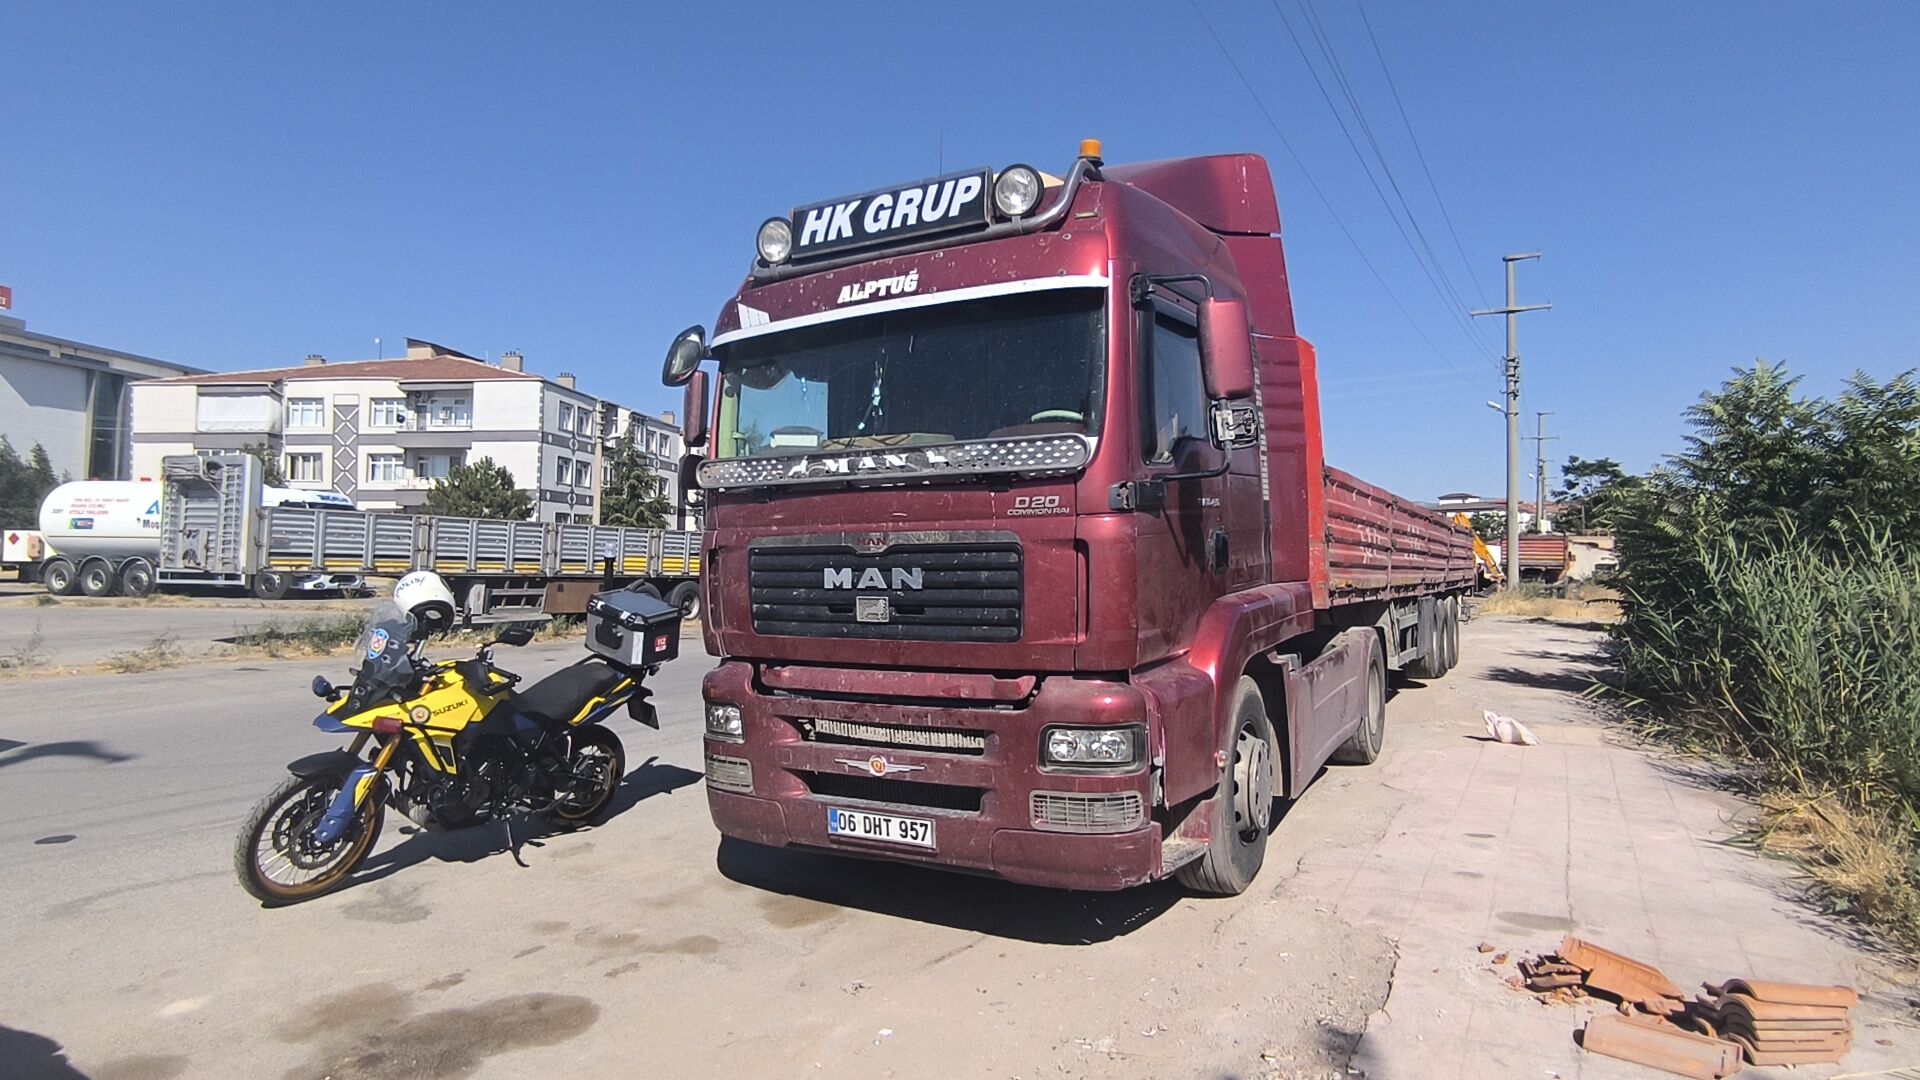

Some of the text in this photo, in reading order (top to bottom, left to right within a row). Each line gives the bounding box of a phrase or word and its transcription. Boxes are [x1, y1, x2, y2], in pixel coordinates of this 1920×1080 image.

[800, 176, 982, 246] HK GRUP
[837, 268, 919, 304] ALPTUĞ
[1007, 507, 1052, 516] COMMON
[856, 537, 887, 546] MAN
[823, 567, 923, 590] MAN
[432, 699, 469, 717] SUZUKI
[838, 812, 929, 842] 06 DHT 957
